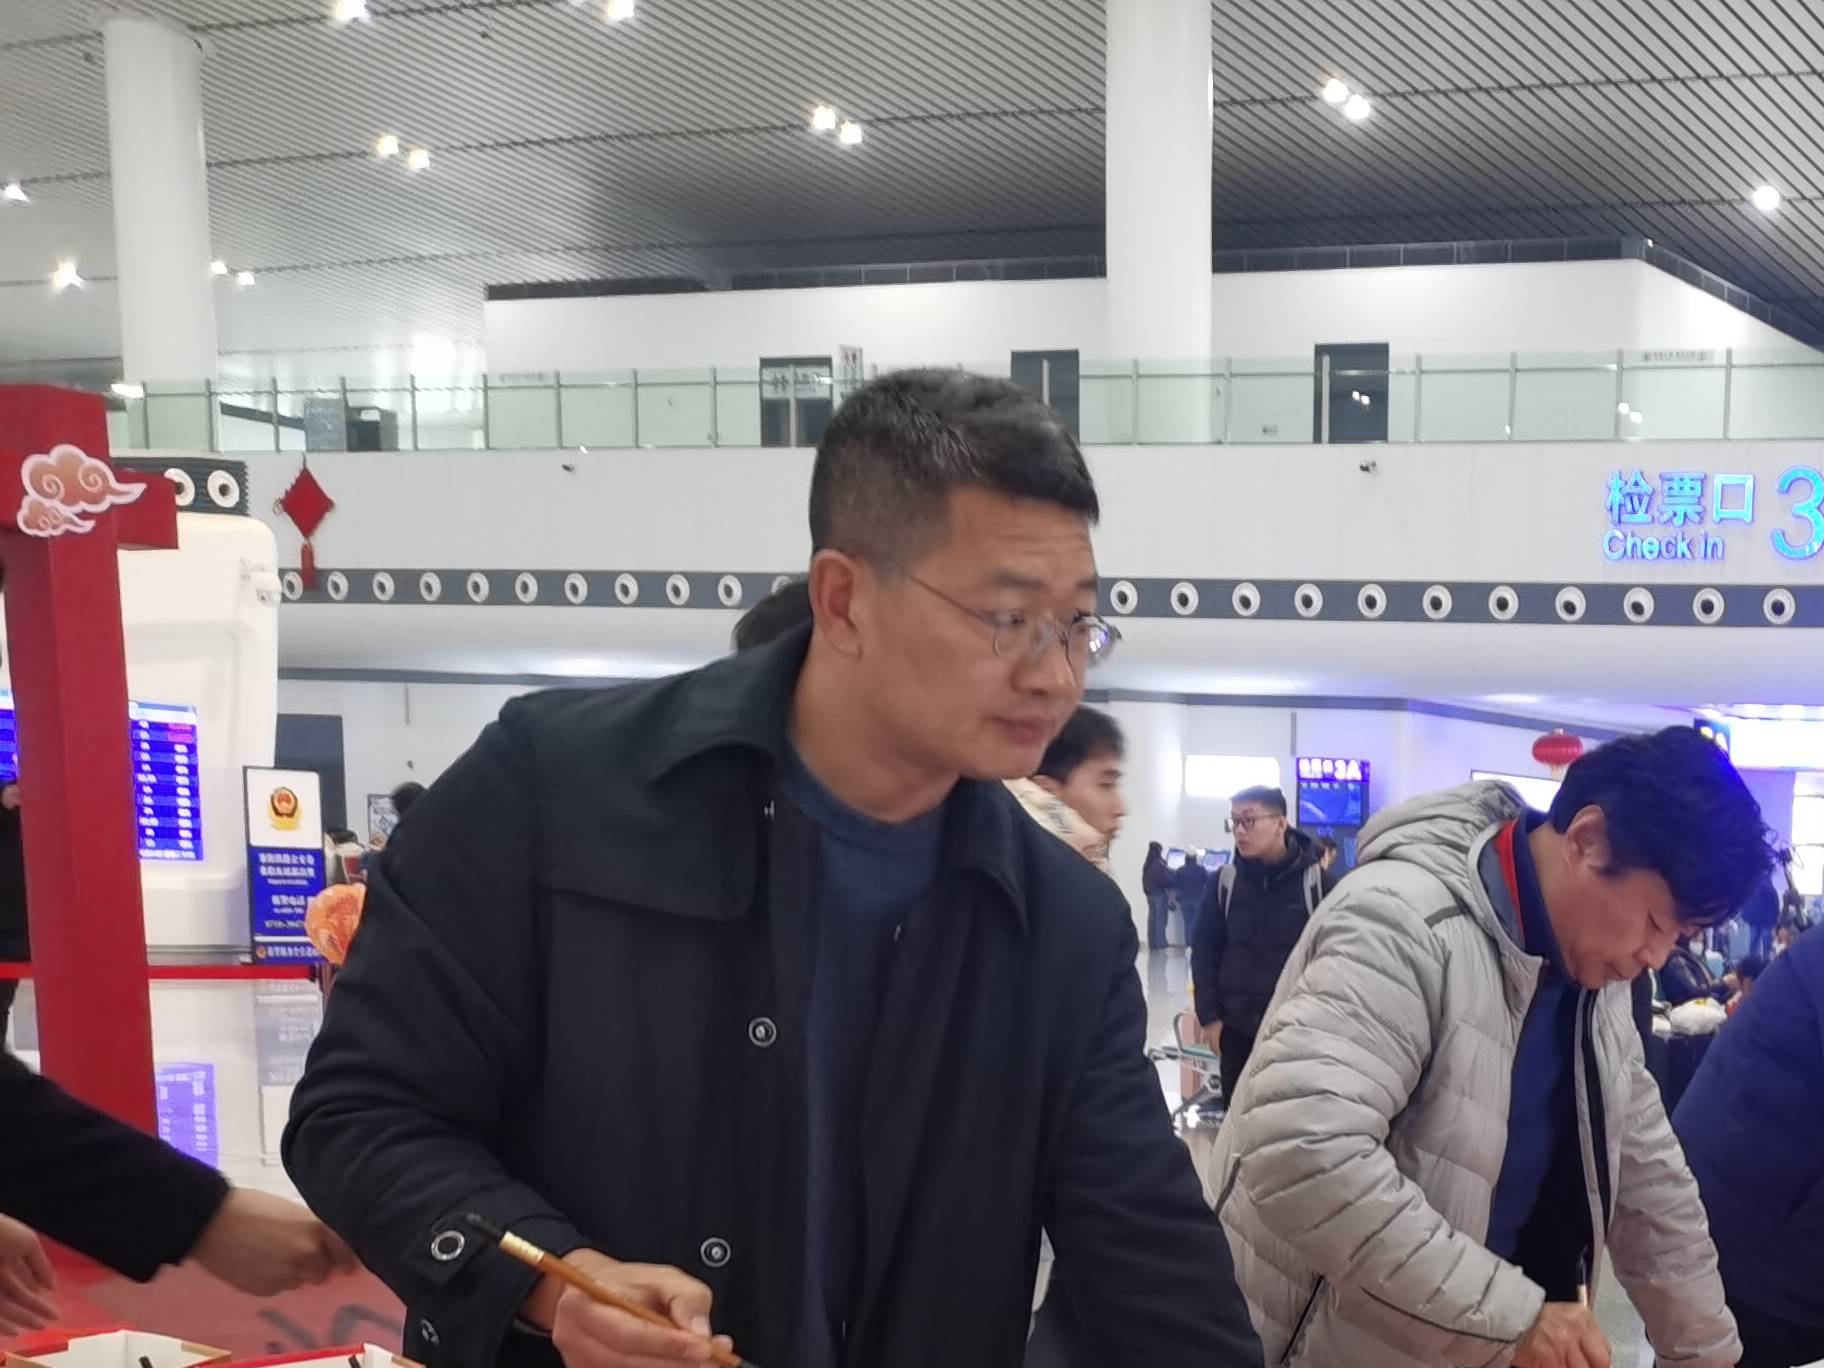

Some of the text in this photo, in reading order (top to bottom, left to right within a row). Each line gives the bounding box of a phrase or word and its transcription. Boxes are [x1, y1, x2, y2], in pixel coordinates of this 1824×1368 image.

[1605, 466, 1756, 526] 检票口
[1603, 529, 1725, 561] Check in
